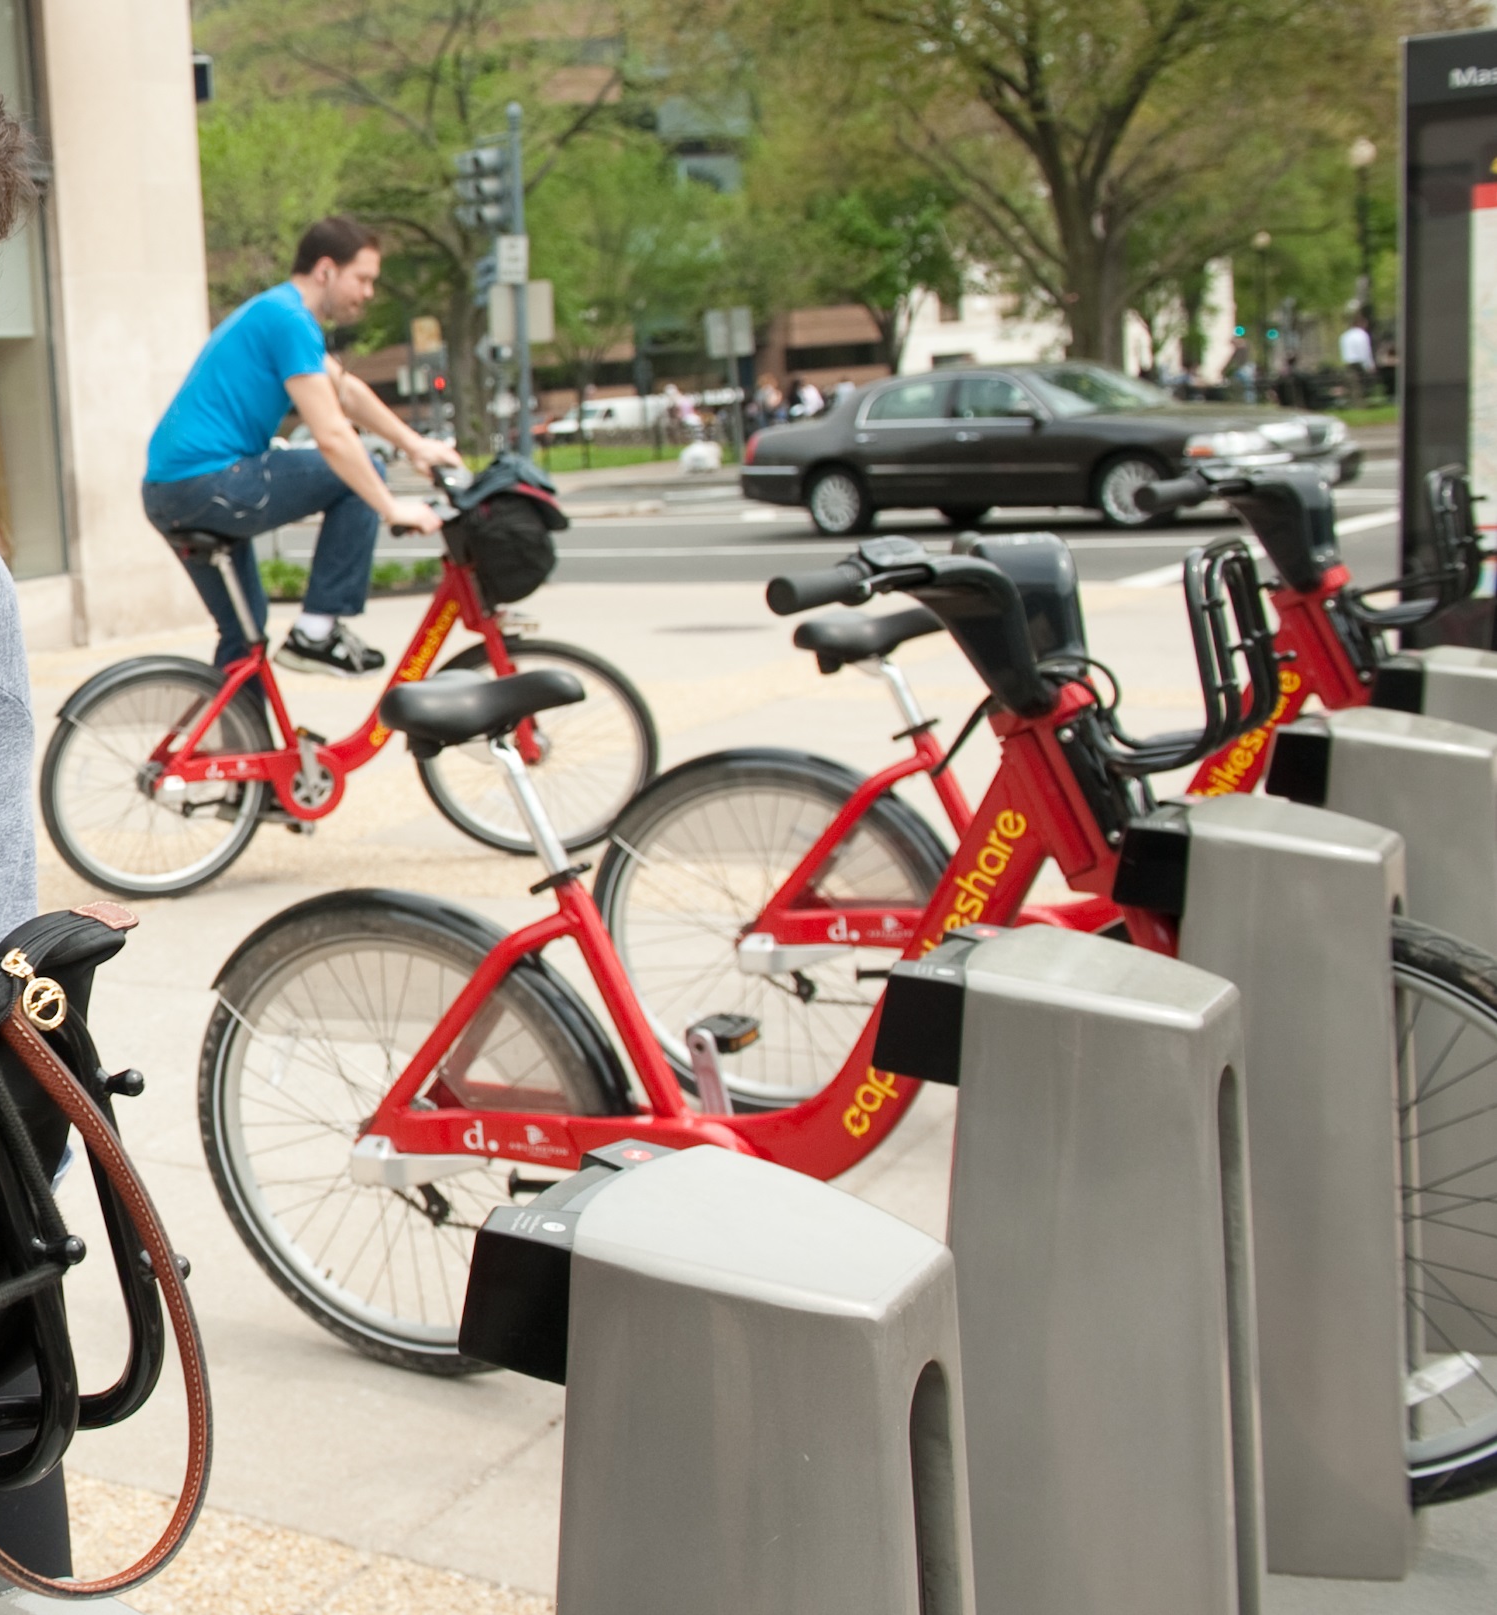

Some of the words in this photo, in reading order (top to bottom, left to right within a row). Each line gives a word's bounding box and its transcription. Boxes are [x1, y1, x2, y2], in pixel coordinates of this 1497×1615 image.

[399, 600, 460, 681] bikeshare
[827, 915, 860, 942] d.
[463, 1120, 499, 1152] d.
